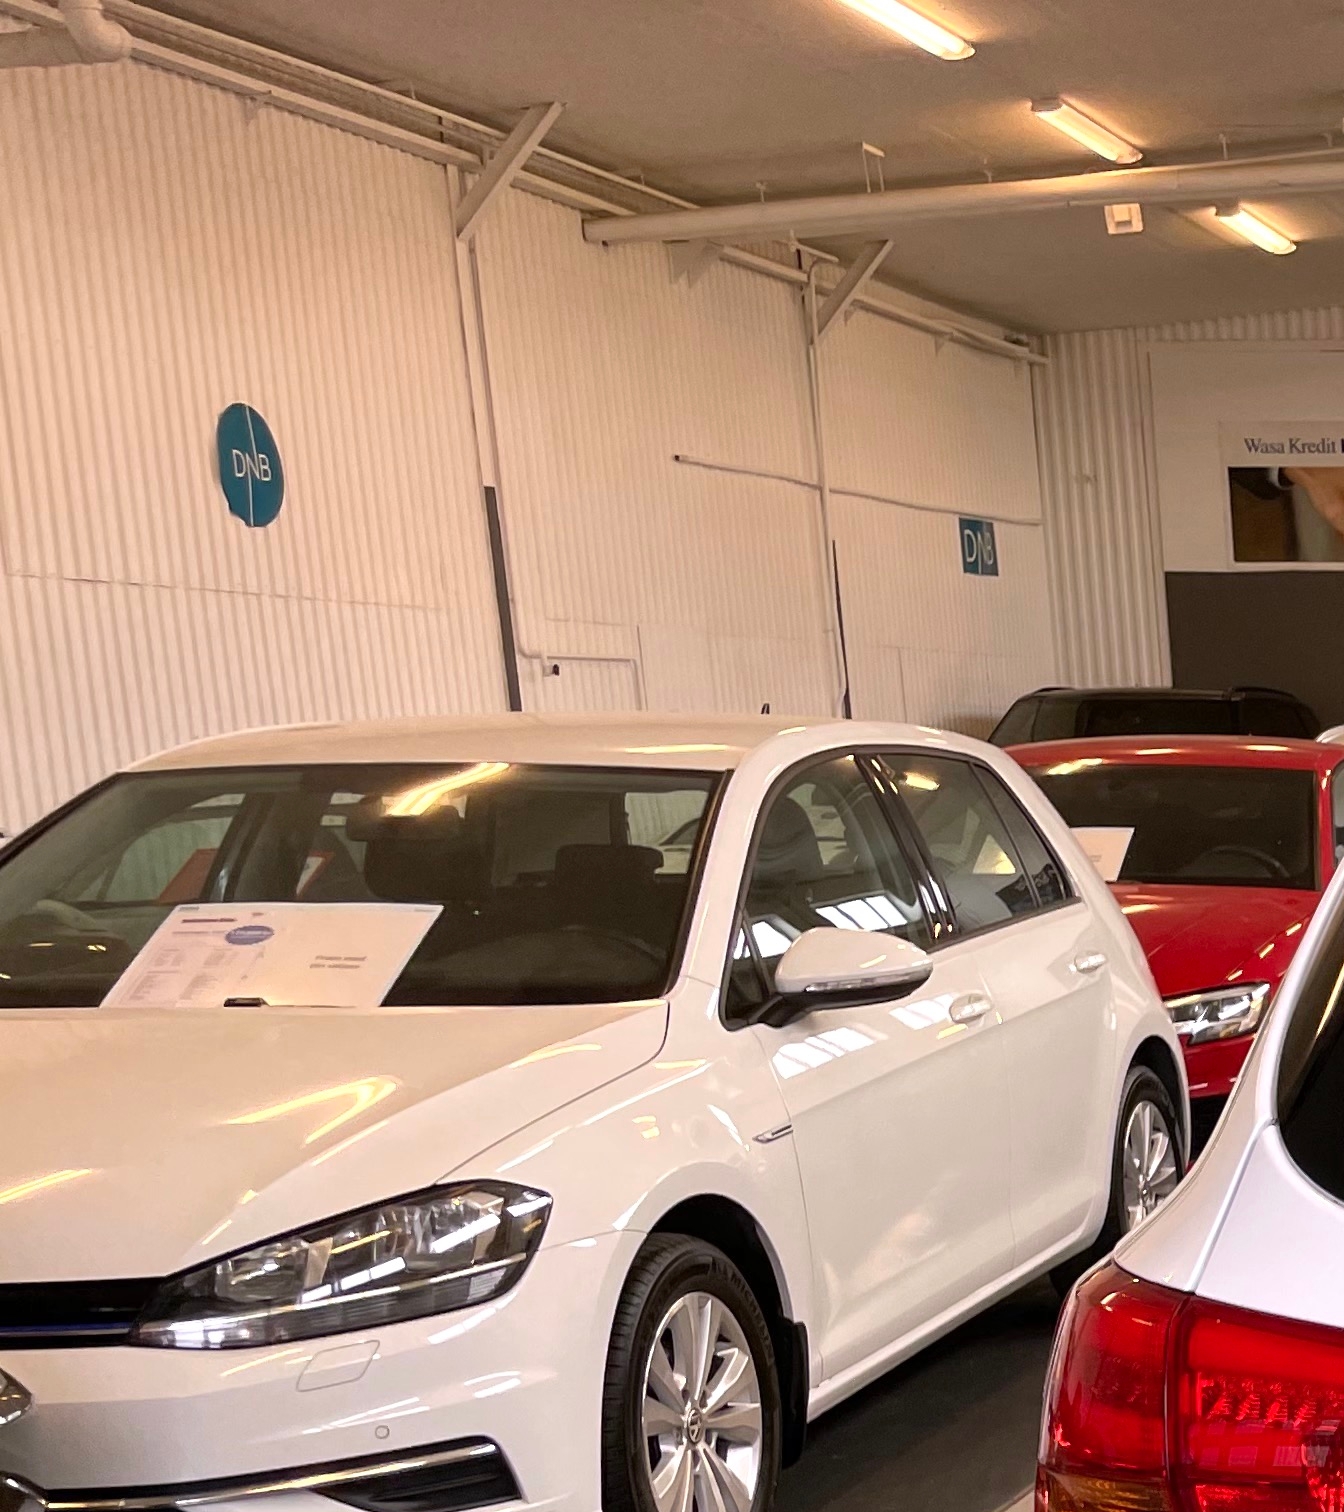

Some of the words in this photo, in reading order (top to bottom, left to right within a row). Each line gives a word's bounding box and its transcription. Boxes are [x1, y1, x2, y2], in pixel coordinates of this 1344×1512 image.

[1243, 437, 1285, 454] Wasa
[1288, 437, 1337, 454] Kredit
[231, 449, 272, 482] DNB
[963, 528, 994, 565] DNB
